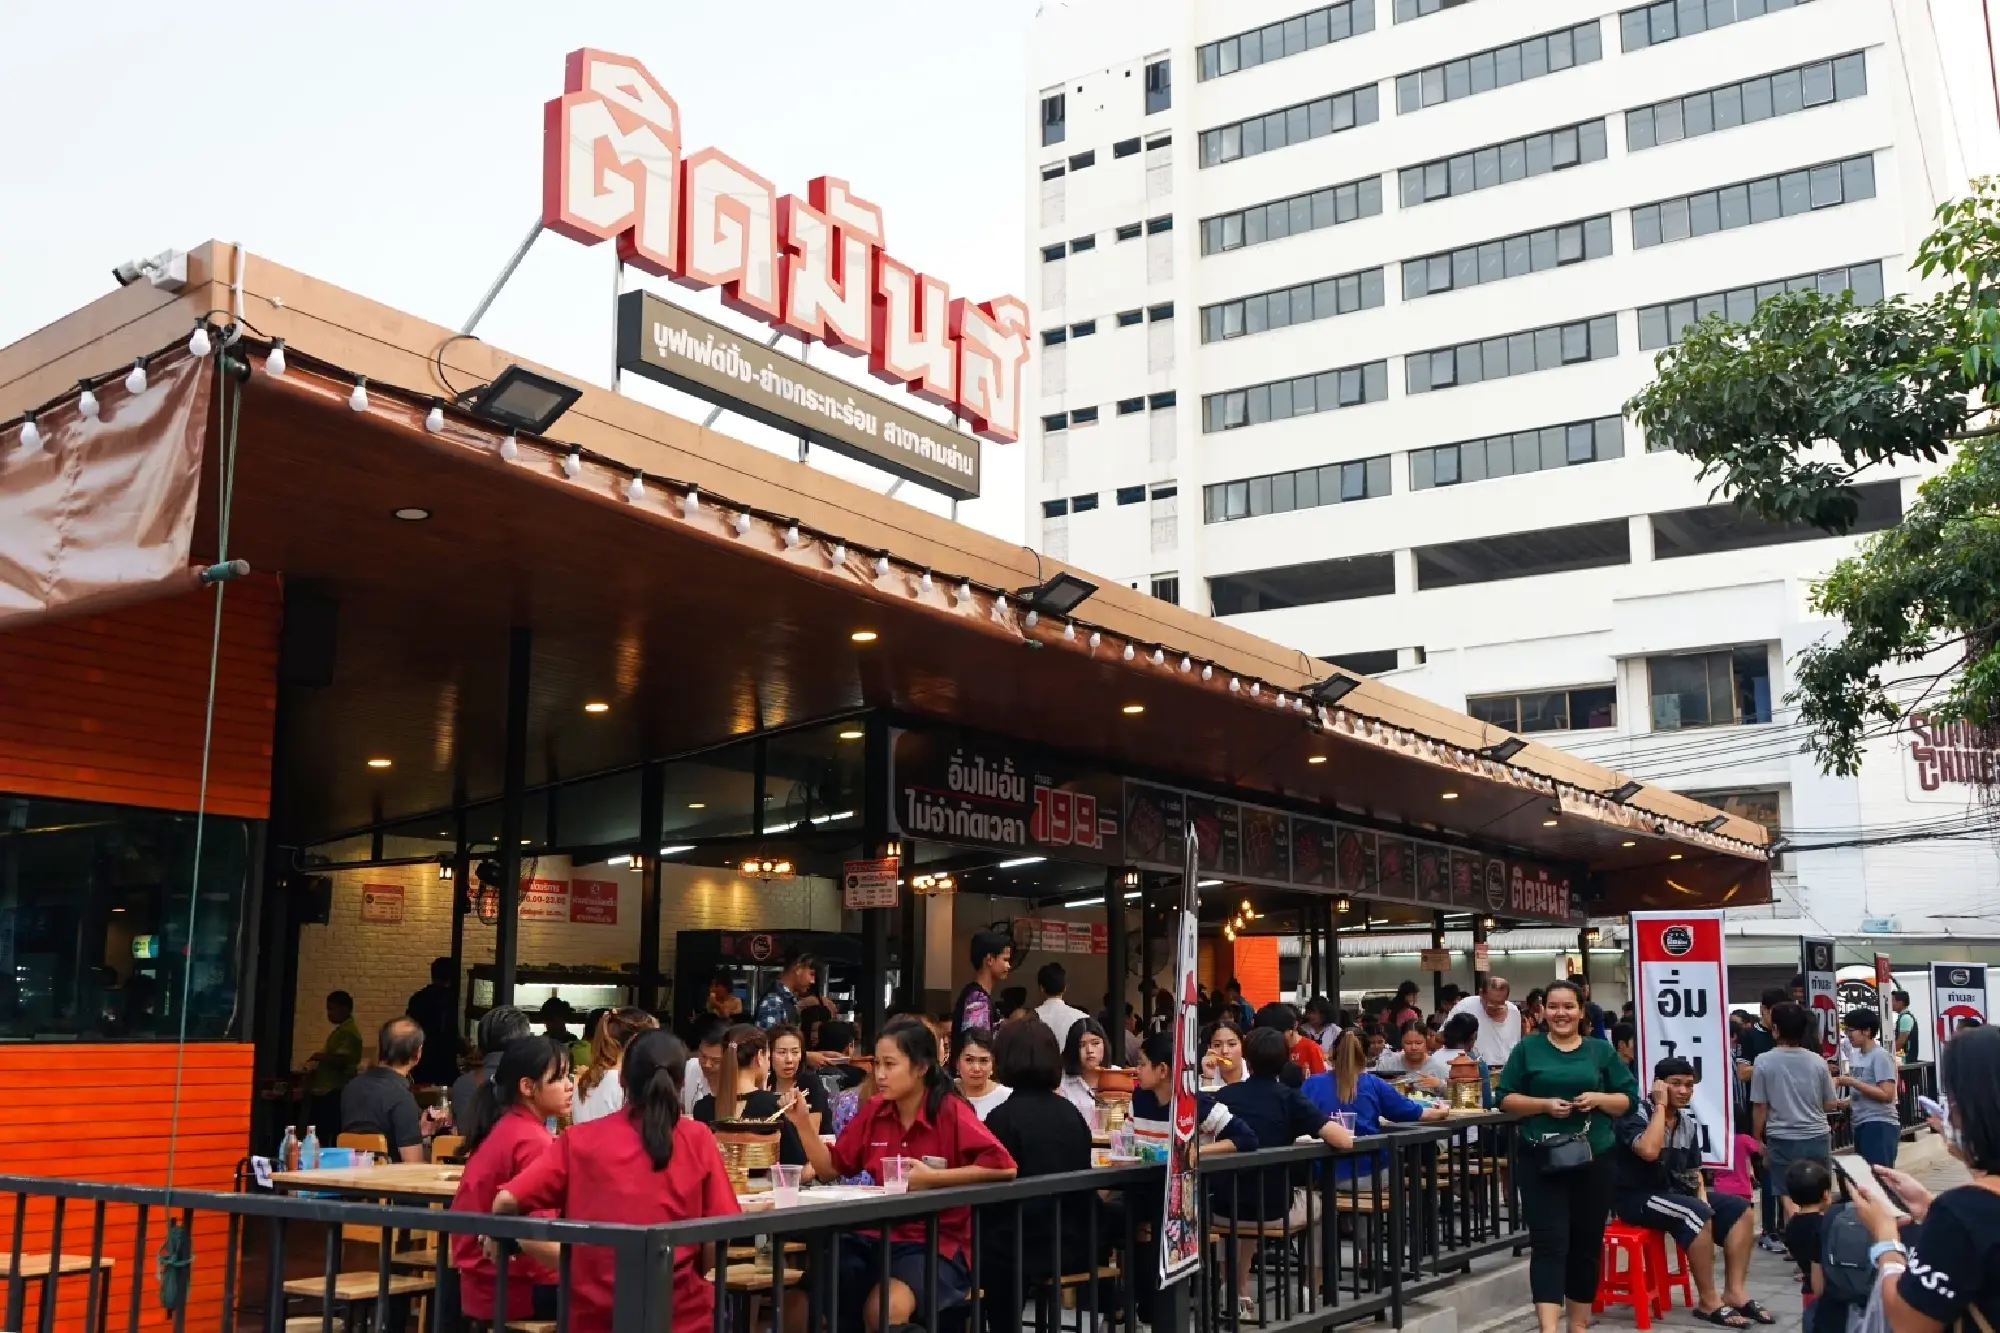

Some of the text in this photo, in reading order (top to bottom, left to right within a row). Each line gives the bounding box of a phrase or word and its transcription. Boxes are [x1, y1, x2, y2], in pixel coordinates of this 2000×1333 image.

[883, 421, 974, 476] สาขาสามย่าน
[947, 748, 1026, 803] อิ่มไม่อั้น
[904, 787, 1026, 846] ไม่จำกัดเวลา
[1657, 969, 1708, 1018] อิ่ม
